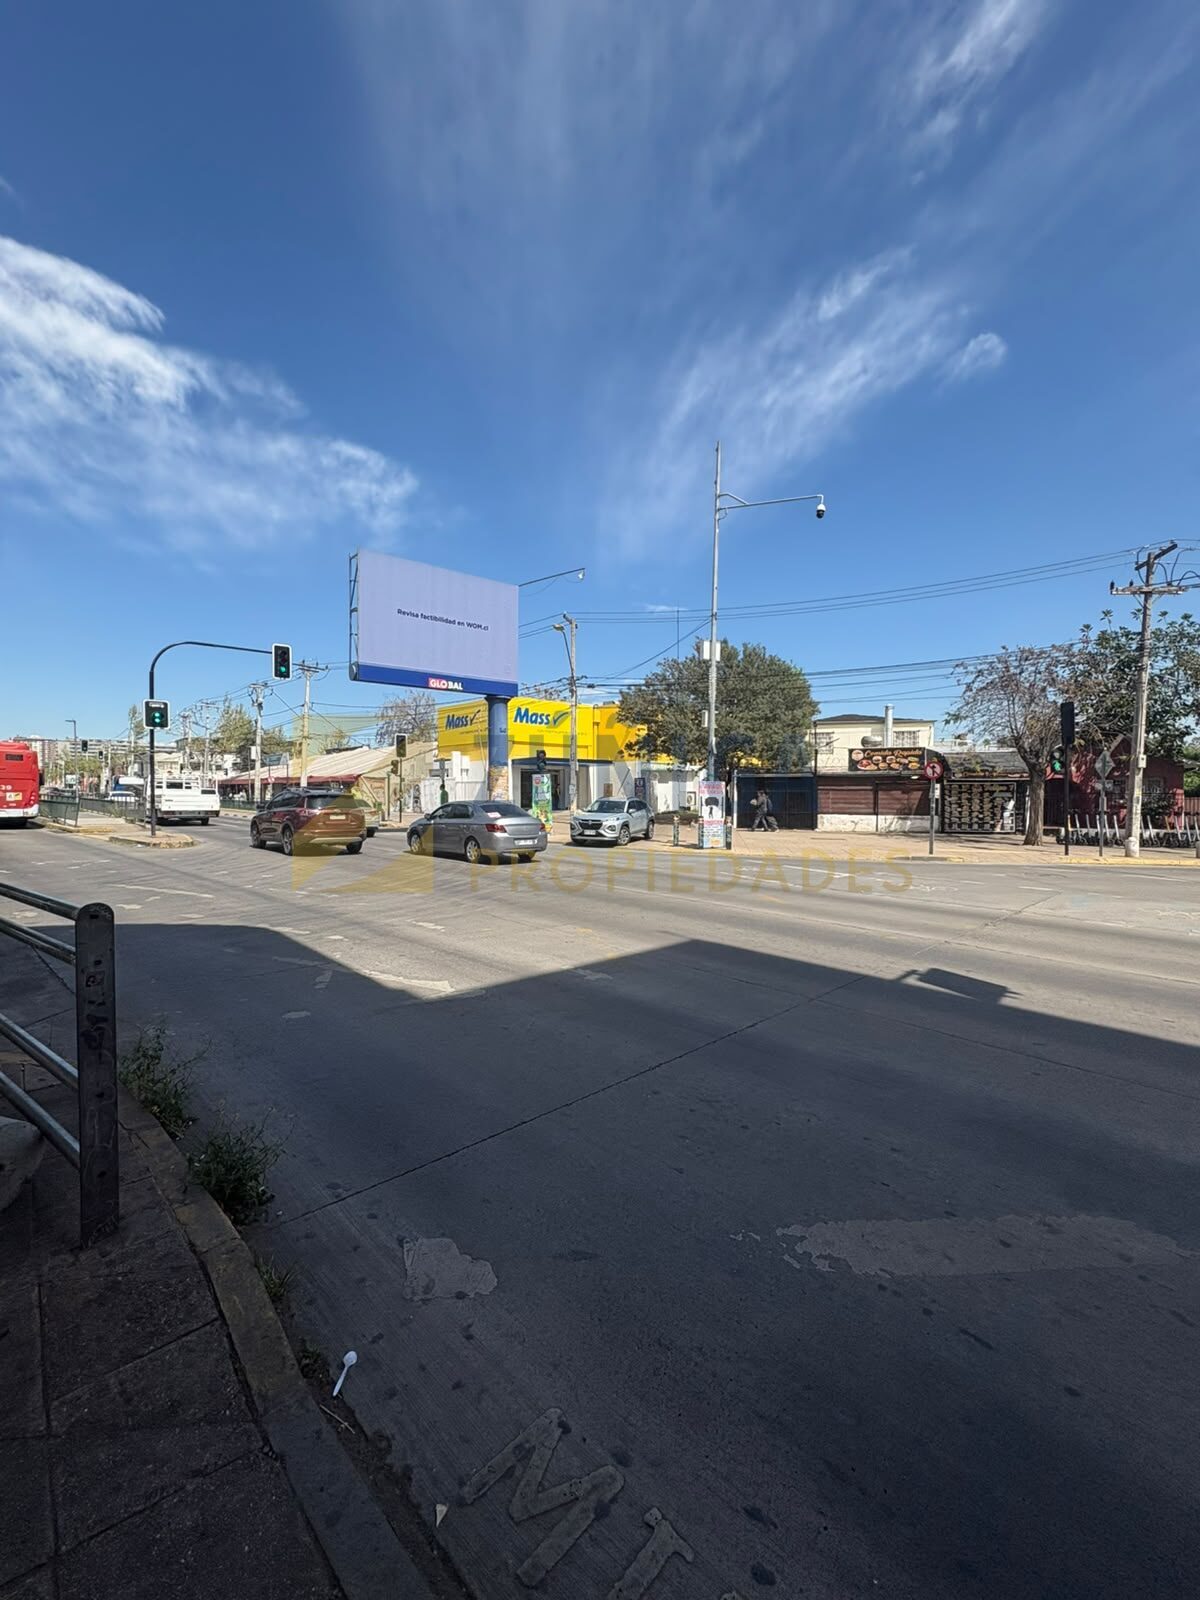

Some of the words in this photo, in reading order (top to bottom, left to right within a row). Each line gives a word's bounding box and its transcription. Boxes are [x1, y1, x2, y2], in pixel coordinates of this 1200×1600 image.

[397, 608, 419, 619] Revisa
[420, 612, 456, 625] factibilidad
[466, 621, 488, 631] WOM.cl
[429, 679, 463, 690] GLOBAL
[445, 713, 469, 730] Mass
[513, 706, 551, 726] Mass
